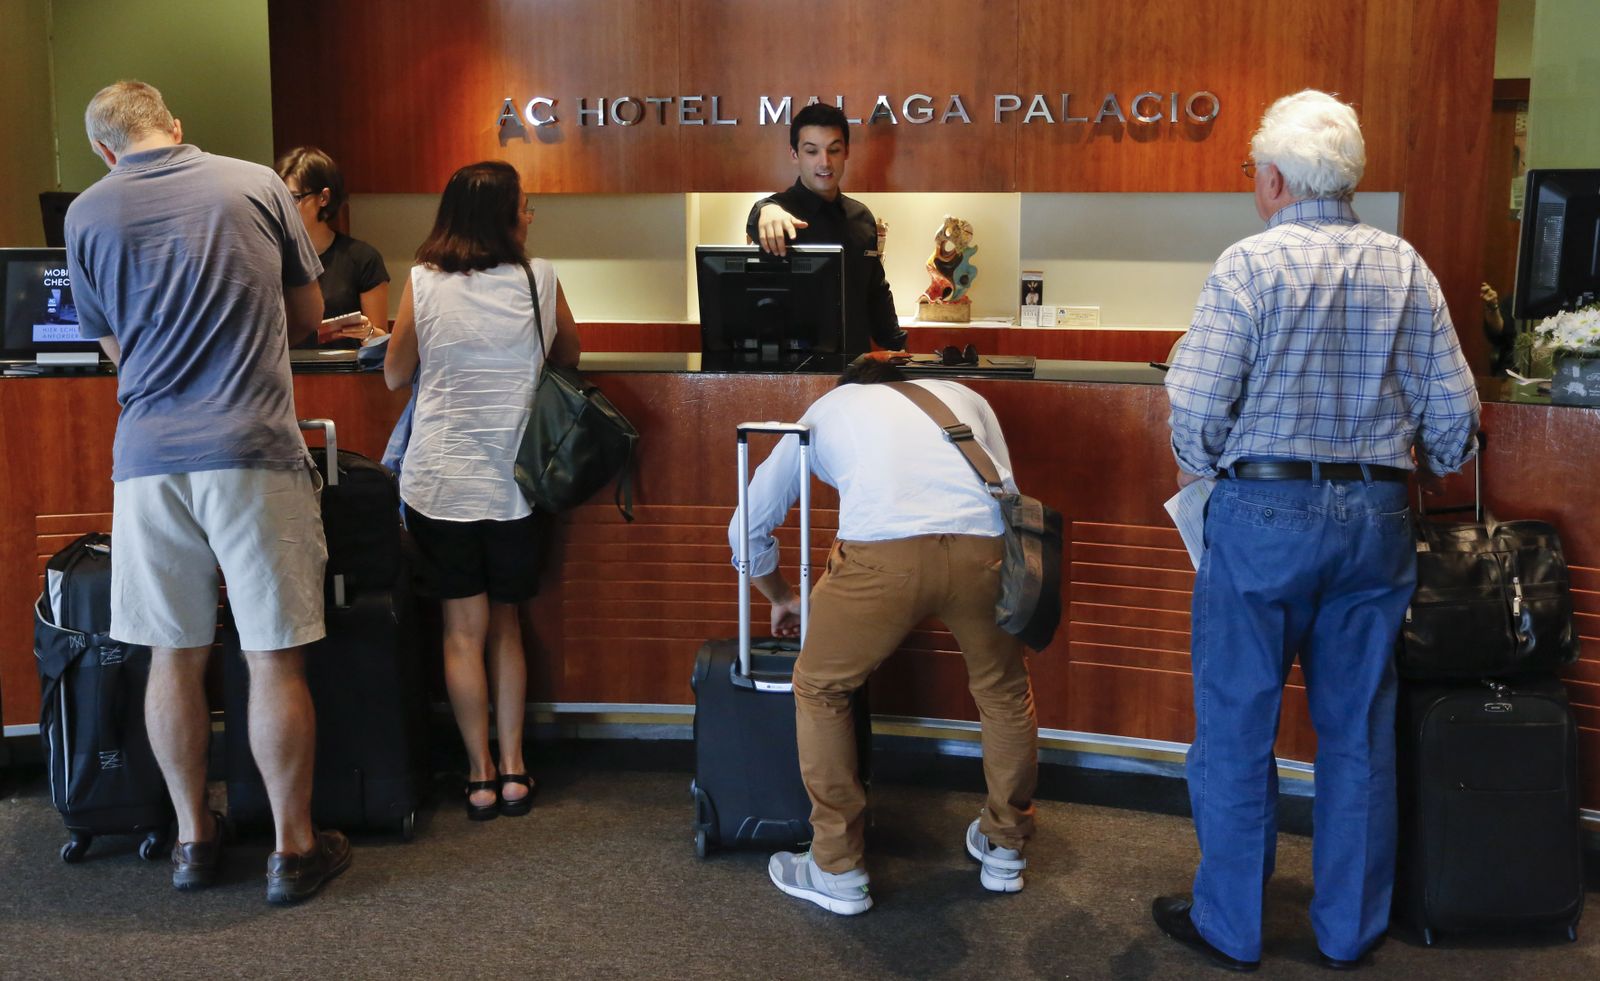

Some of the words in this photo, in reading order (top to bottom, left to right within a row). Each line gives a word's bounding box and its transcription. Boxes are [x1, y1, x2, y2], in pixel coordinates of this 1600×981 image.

[497, 96, 556, 127] AC
[576, 95, 738, 126] HOTEL
[994, 90, 1220, 123] PALACIO
